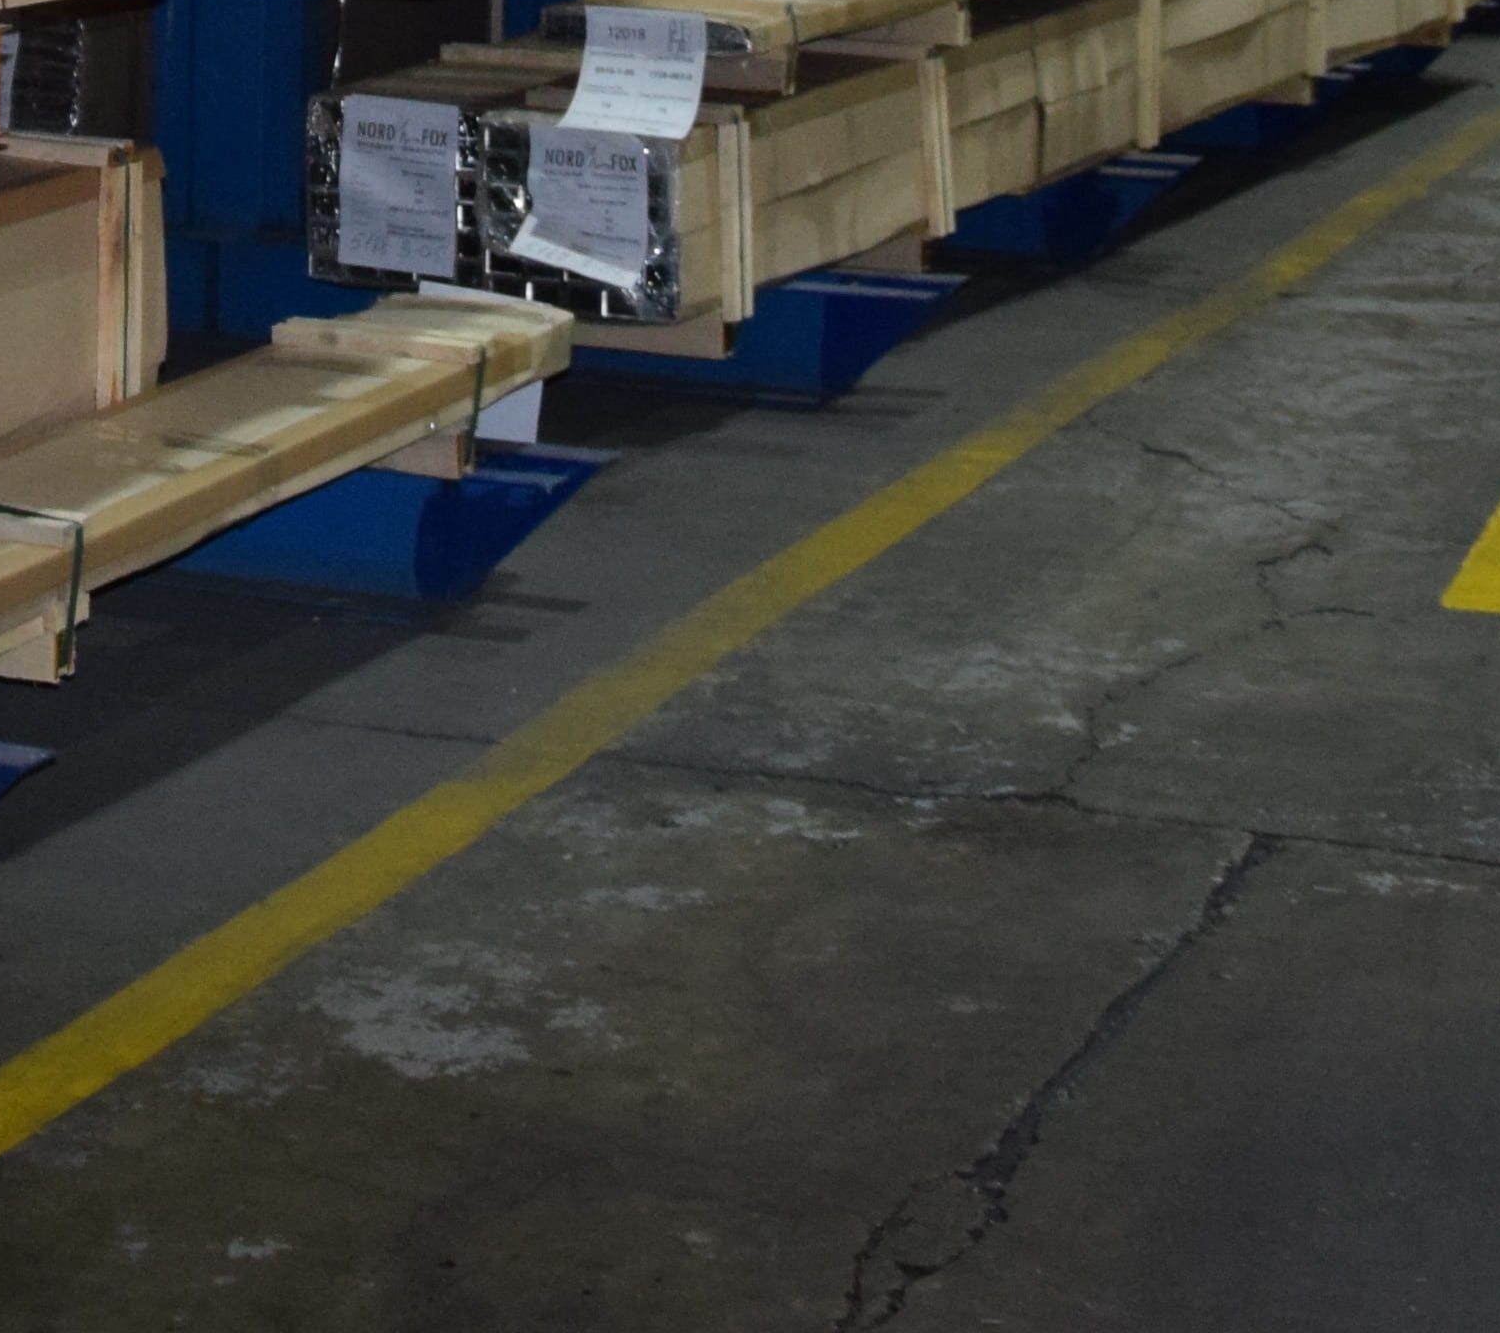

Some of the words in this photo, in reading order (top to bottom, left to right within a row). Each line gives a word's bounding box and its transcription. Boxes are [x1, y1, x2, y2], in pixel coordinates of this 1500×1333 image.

[356, 120, 396, 142] NORD
[421, 127, 448, 147] FOX
[543, 147, 585, 168] NORD
[610, 153, 638, 172] FOX
